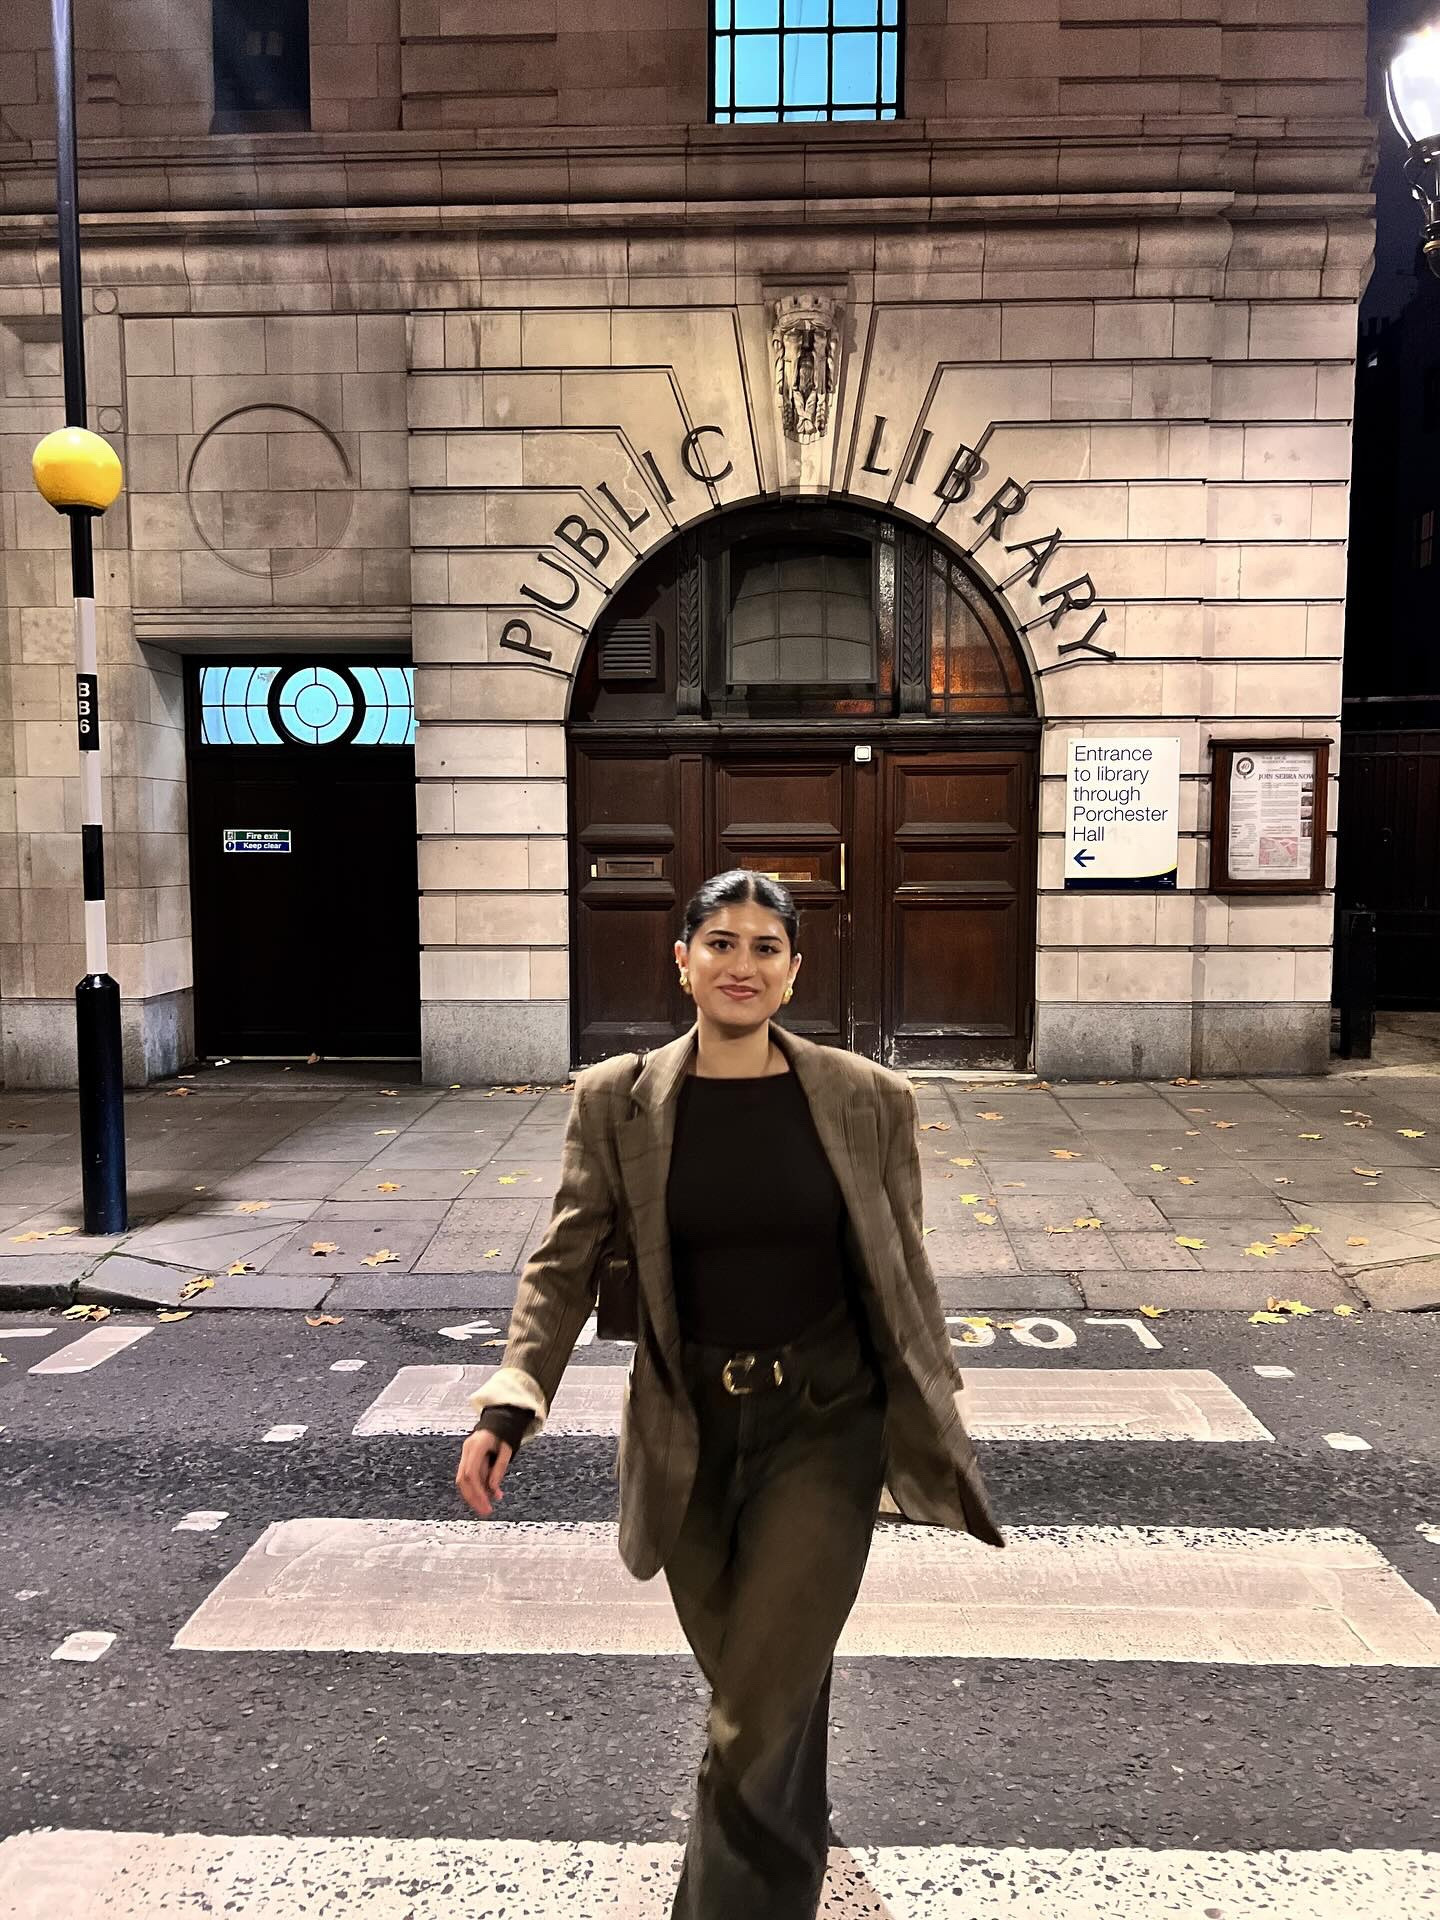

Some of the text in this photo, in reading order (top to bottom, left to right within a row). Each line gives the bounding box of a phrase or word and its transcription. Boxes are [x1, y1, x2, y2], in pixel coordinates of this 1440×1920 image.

[500, 415, 1117, 662] PUBLIC LIBRARY
[1075, 745, 1153, 762] Entrance
[1073, 766, 1149, 785] to library
[1073, 786, 1141, 805] through
[1073, 806, 1168, 822] Porchester
[246, 832, 279, 840] Fire exit
[1073, 826, 1105, 842] Hall
[243, 842, 262, 850] Keep
[944, 1316, 1164, 1350] LOO
